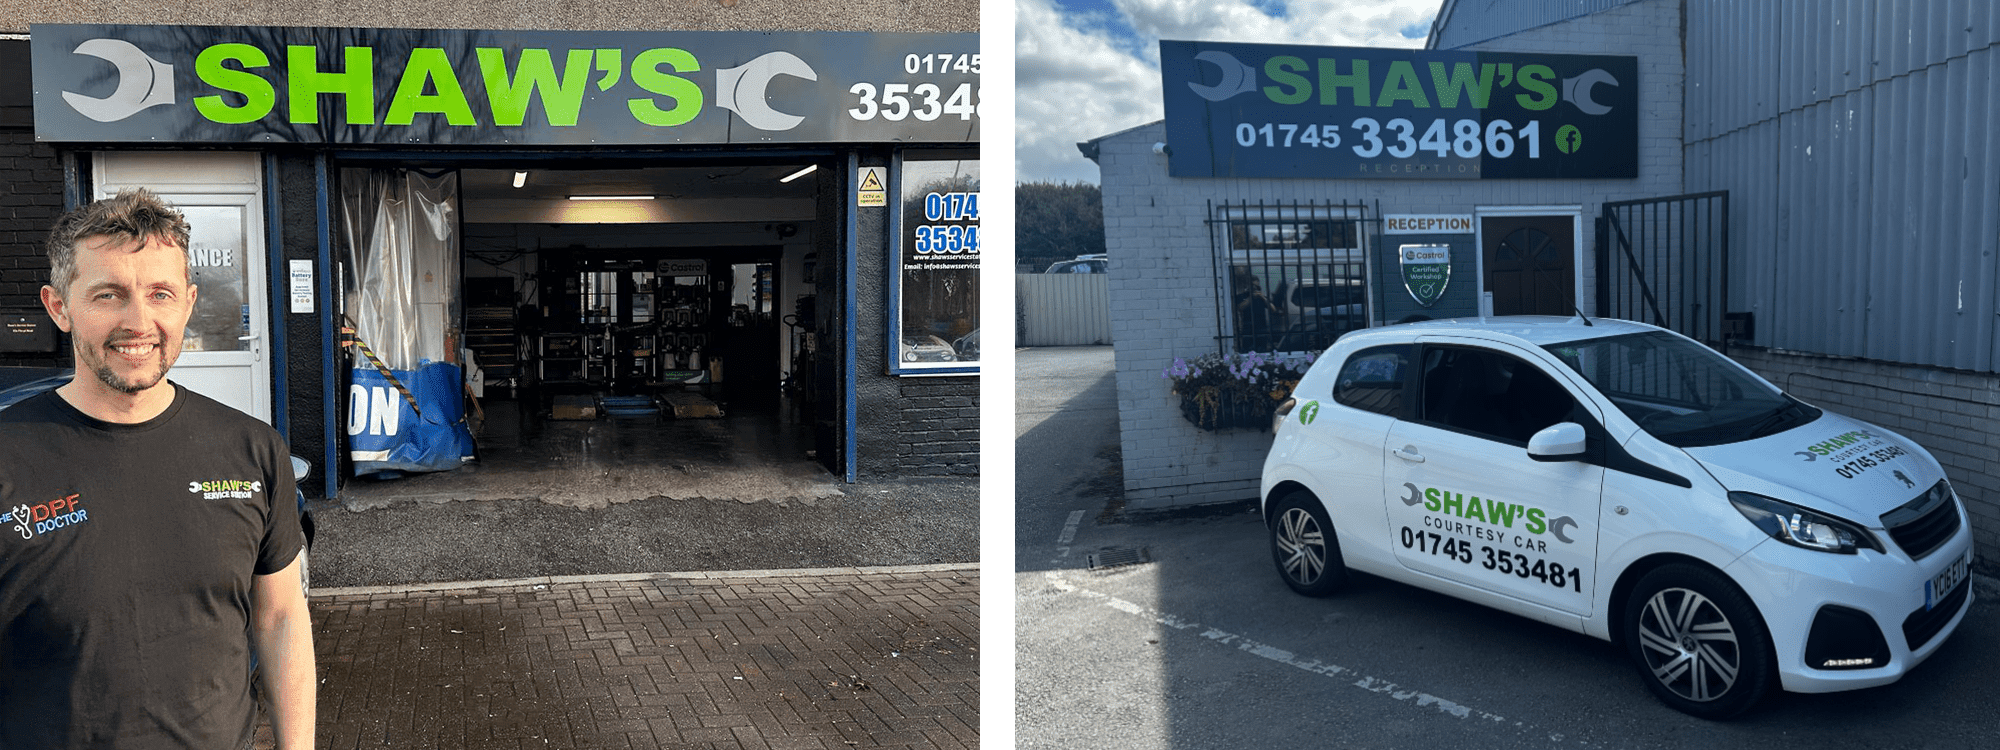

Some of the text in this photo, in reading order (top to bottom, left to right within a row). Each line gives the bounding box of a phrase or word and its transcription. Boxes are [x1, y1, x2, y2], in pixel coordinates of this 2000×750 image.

[904, 53, 980, 74] 01745
[193, 43, 704, 127] SHAW'S
[1263, 56, 1558, 111] SHAW'S
[848, 82, 980, 121] 3534
[1236, 117, 1540, 159] 01745 334861
[1360, 164, 1480, 173] RECEPTION
[925, 192, 980, 221] 0174
[1388, 218, 1471, 231] RECEPTION
[915, 225, 980, 254] 3534
[671, 263, 704, 271] Castrol
[1416, 252, 1445, 260] Castrol
[347, 384, 400, 436] ON
[1836, 456, 1877, 479] 01745
[202, 480, 252, 491] SHAW'S
[31, 493, 80, 522] DPF
[36, 509, 88, 534] DOCTOR
[1424, 487, 1547, 535] SHAW'S
[1424, 515, 1547, 554] COURTESY CAR
[1401, 526, 1582, 593] 01745 353481
